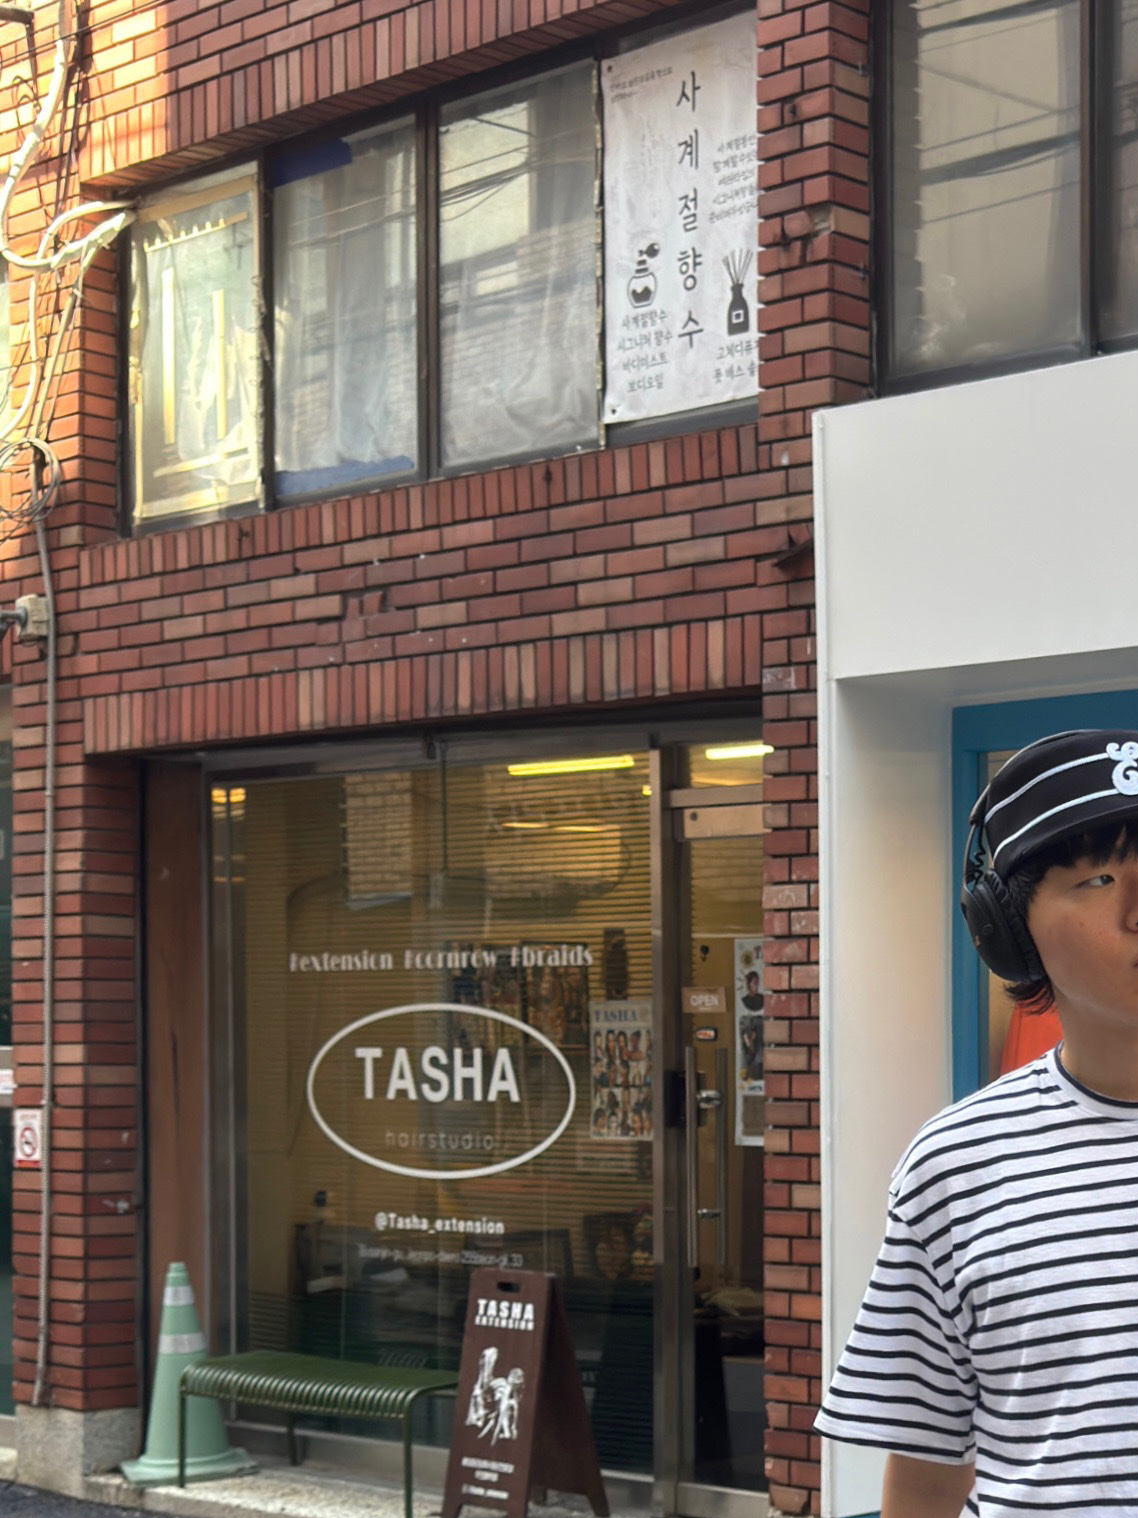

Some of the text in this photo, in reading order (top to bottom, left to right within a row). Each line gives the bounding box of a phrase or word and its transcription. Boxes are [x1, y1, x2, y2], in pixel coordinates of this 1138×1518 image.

[676, 70, 704, 349] 사계절향수
[289, 944, 594, 972] #extension #cornrow #braids
[690, 995, 720, 1007] OPEN
[594, 1008, 638, 1023] TASHA
[355, 1046, 521, 1103] TASHA
[385, 1131, 495, 1151] hairstudio
[375, 1211, 505, 1235] @Tasha_extension
[477, 1298, 534, 1321] TASHA
[475, 1314, 535, 1331] EXTENSION
